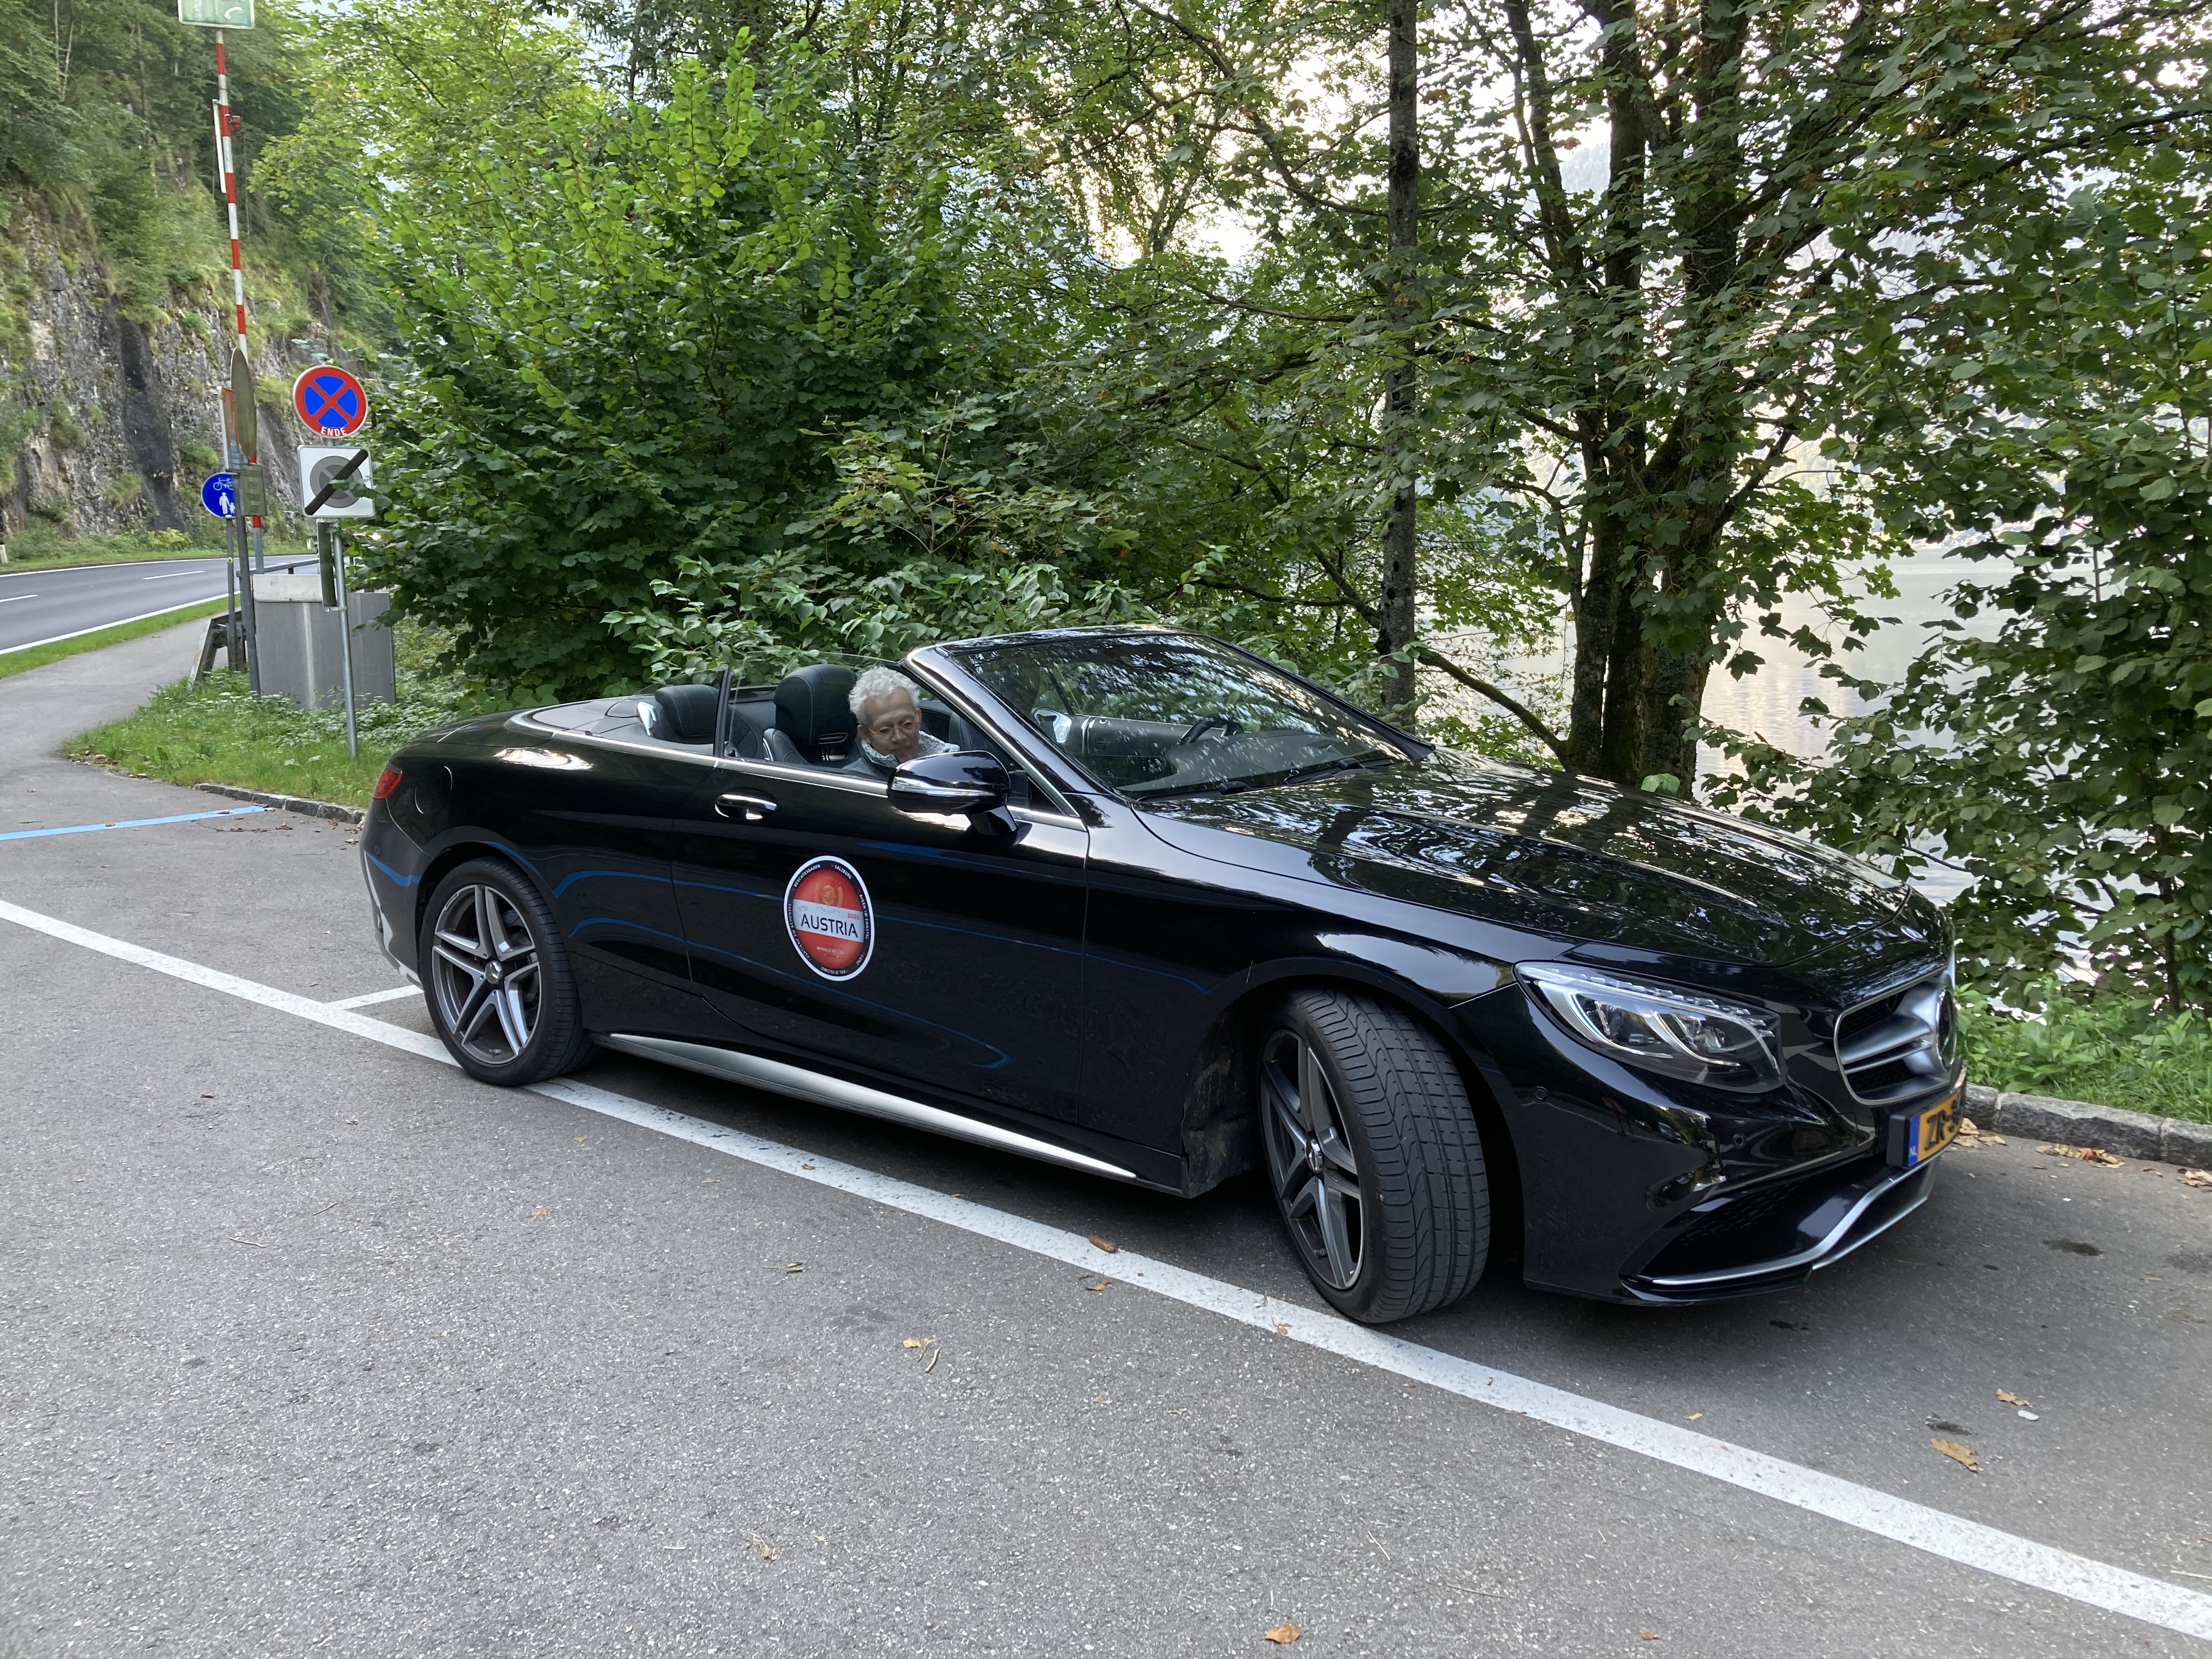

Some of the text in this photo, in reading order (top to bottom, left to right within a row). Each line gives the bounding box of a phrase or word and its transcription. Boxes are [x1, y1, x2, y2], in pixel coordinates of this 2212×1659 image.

[320, 426, 347, 436] ENDE
[834, 865, 852, 879] SALZBURG
[800, 913, 858, 938] AUSTRIA
[1909, 1147, 1917, 1158] NL
